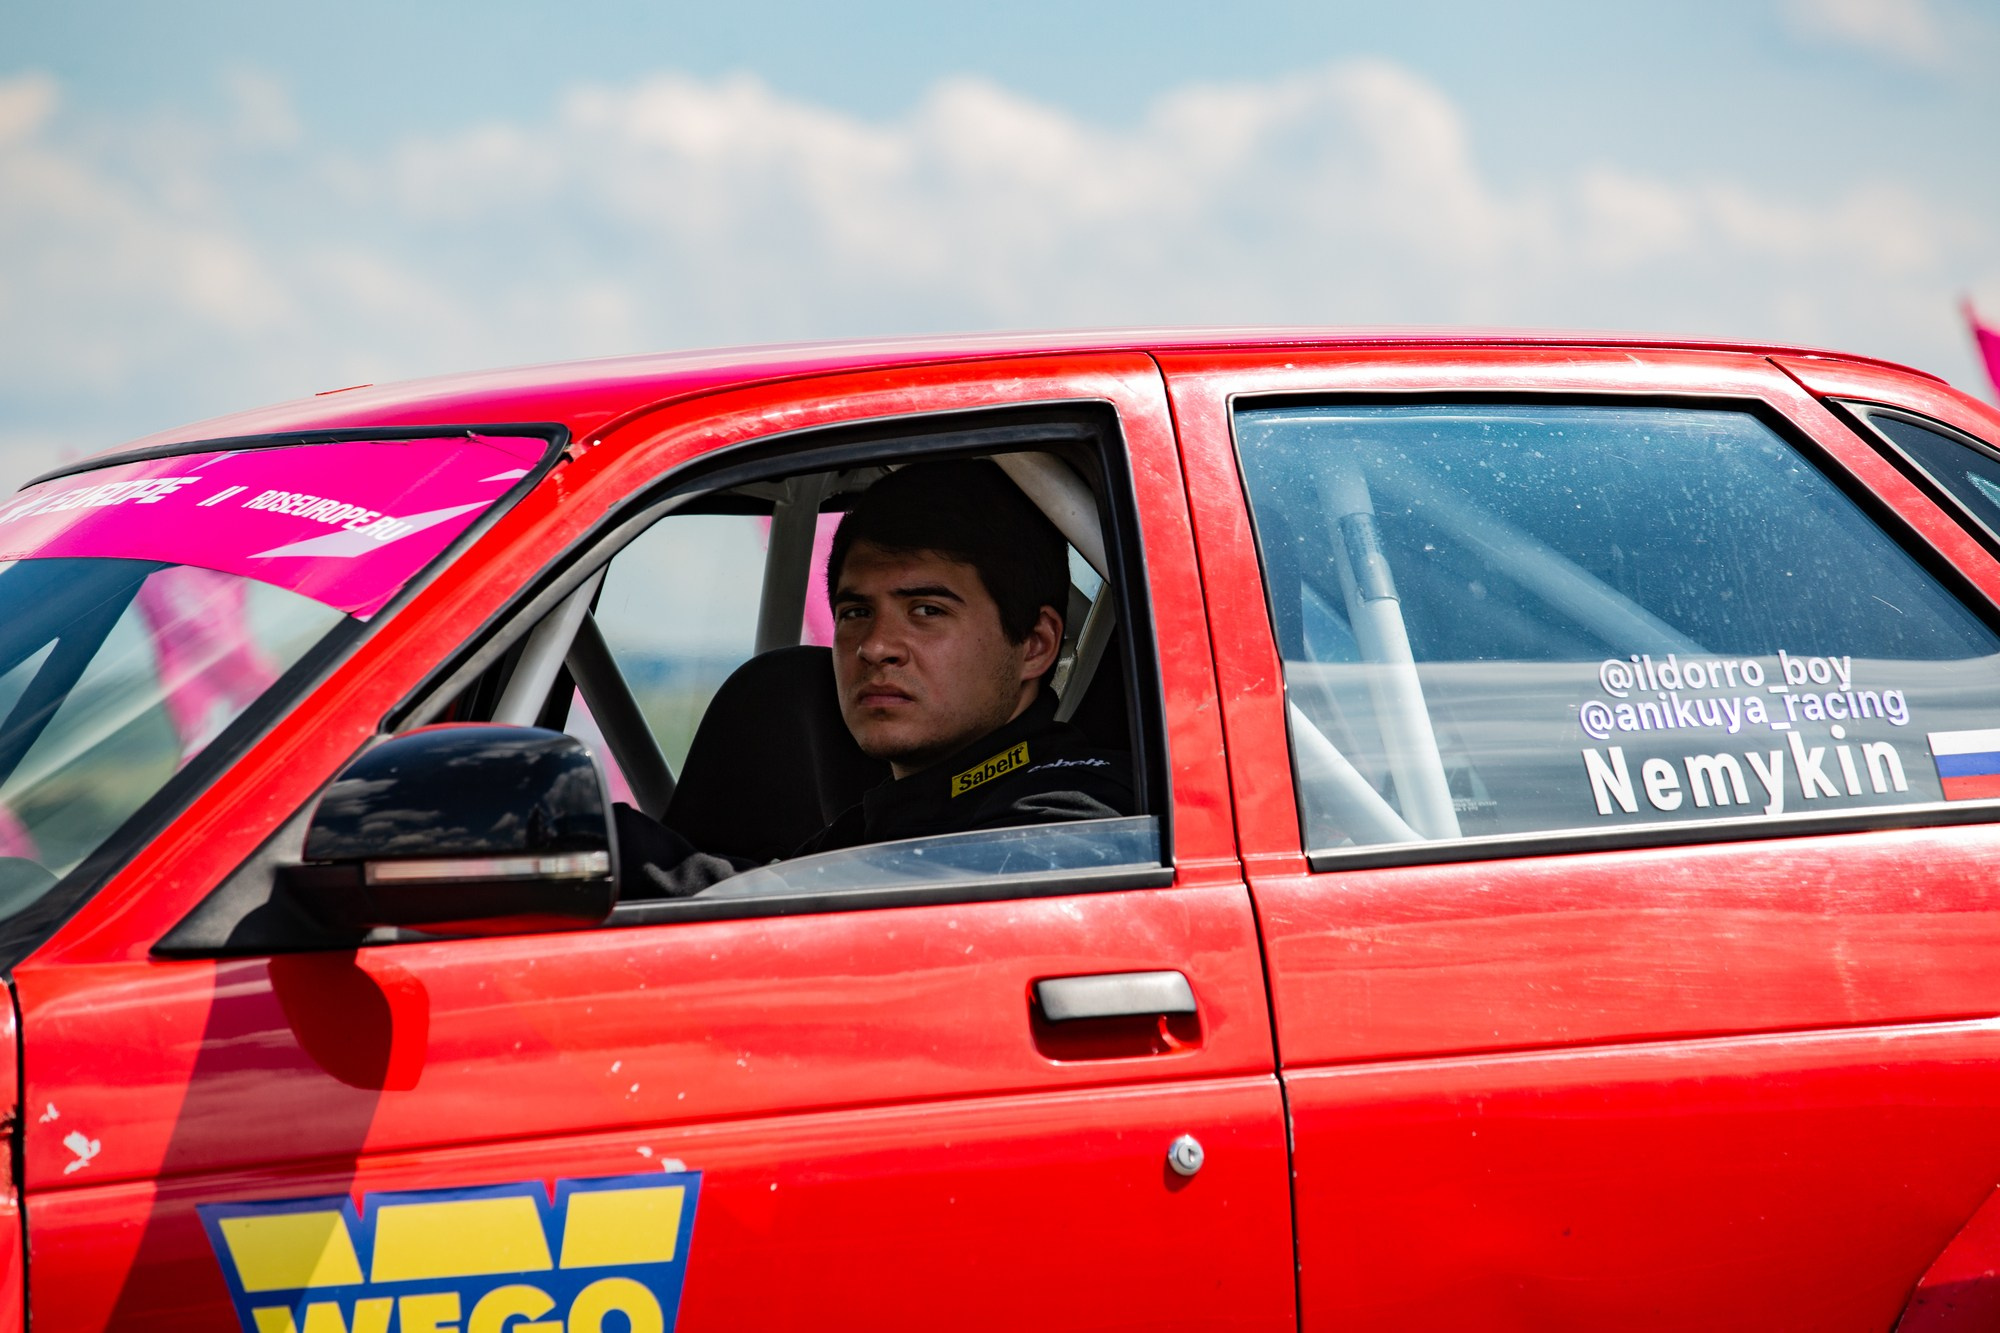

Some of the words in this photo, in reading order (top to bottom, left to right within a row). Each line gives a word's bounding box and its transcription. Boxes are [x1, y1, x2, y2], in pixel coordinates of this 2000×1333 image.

[30, 476, 203, 516] EUROPE
[244, 489, 414, 542] RDSEUROPE.RU
[1599, 649, 1852, 698] @ildorro_boy
[1579, 690, 1910, 740] @anikuya_racing
[959, 747, 1025, 791] Sabelt
[1582, 725, 1910, 816] Nemykin
